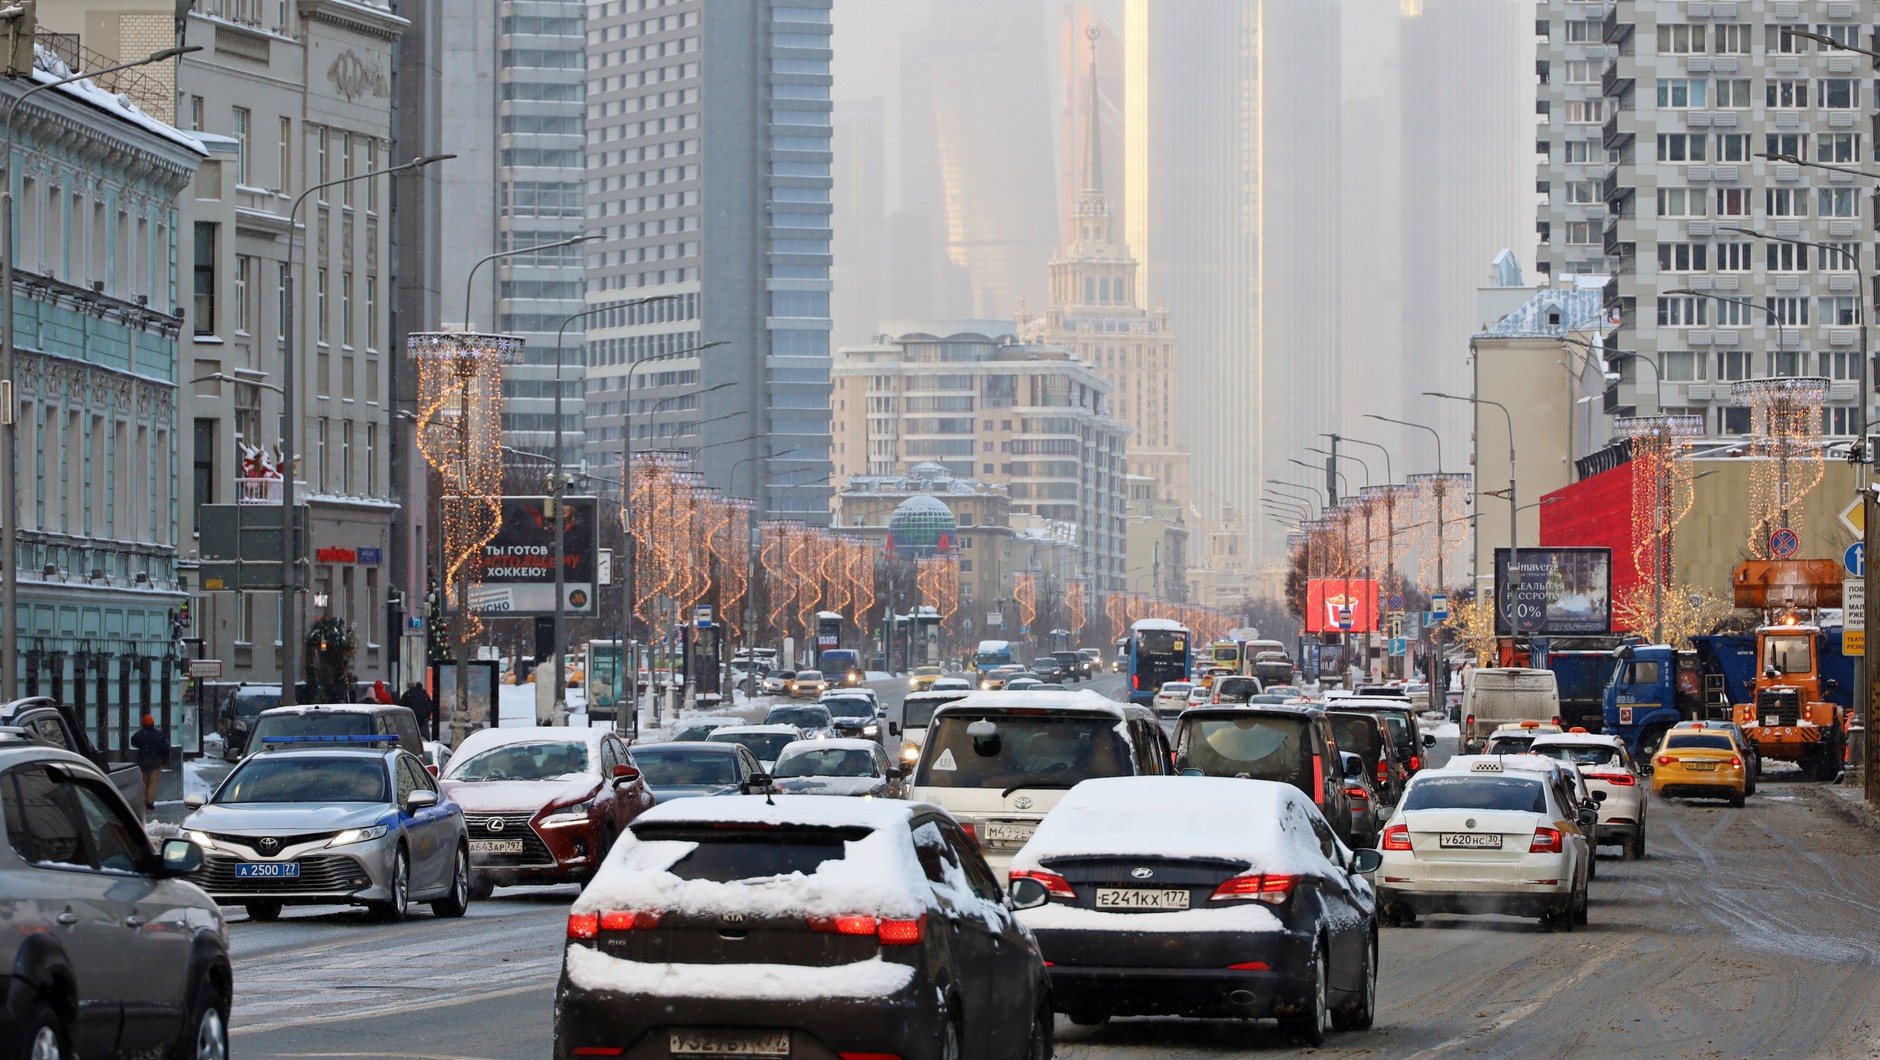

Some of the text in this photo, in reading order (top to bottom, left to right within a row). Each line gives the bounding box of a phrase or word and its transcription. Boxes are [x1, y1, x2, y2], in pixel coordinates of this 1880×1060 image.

[486, 546, 548, 555] ТЫ ГОТОВ
[1507, 562, 1558, 571] imavera
[487, 567, 547, 577] ХОККЕЮ?
[1507, 582, 1565, 590] ЕАЛЬНАЯ
[1445, 835, 1498, 845] У620НС 30
[470, 842, 504, 852] А643АР
[241, 864, 296, 876] А 2500 77
[1101, 891, 1186, 905] Е241КХ 177
[722, 912, 744, 922] KIA
